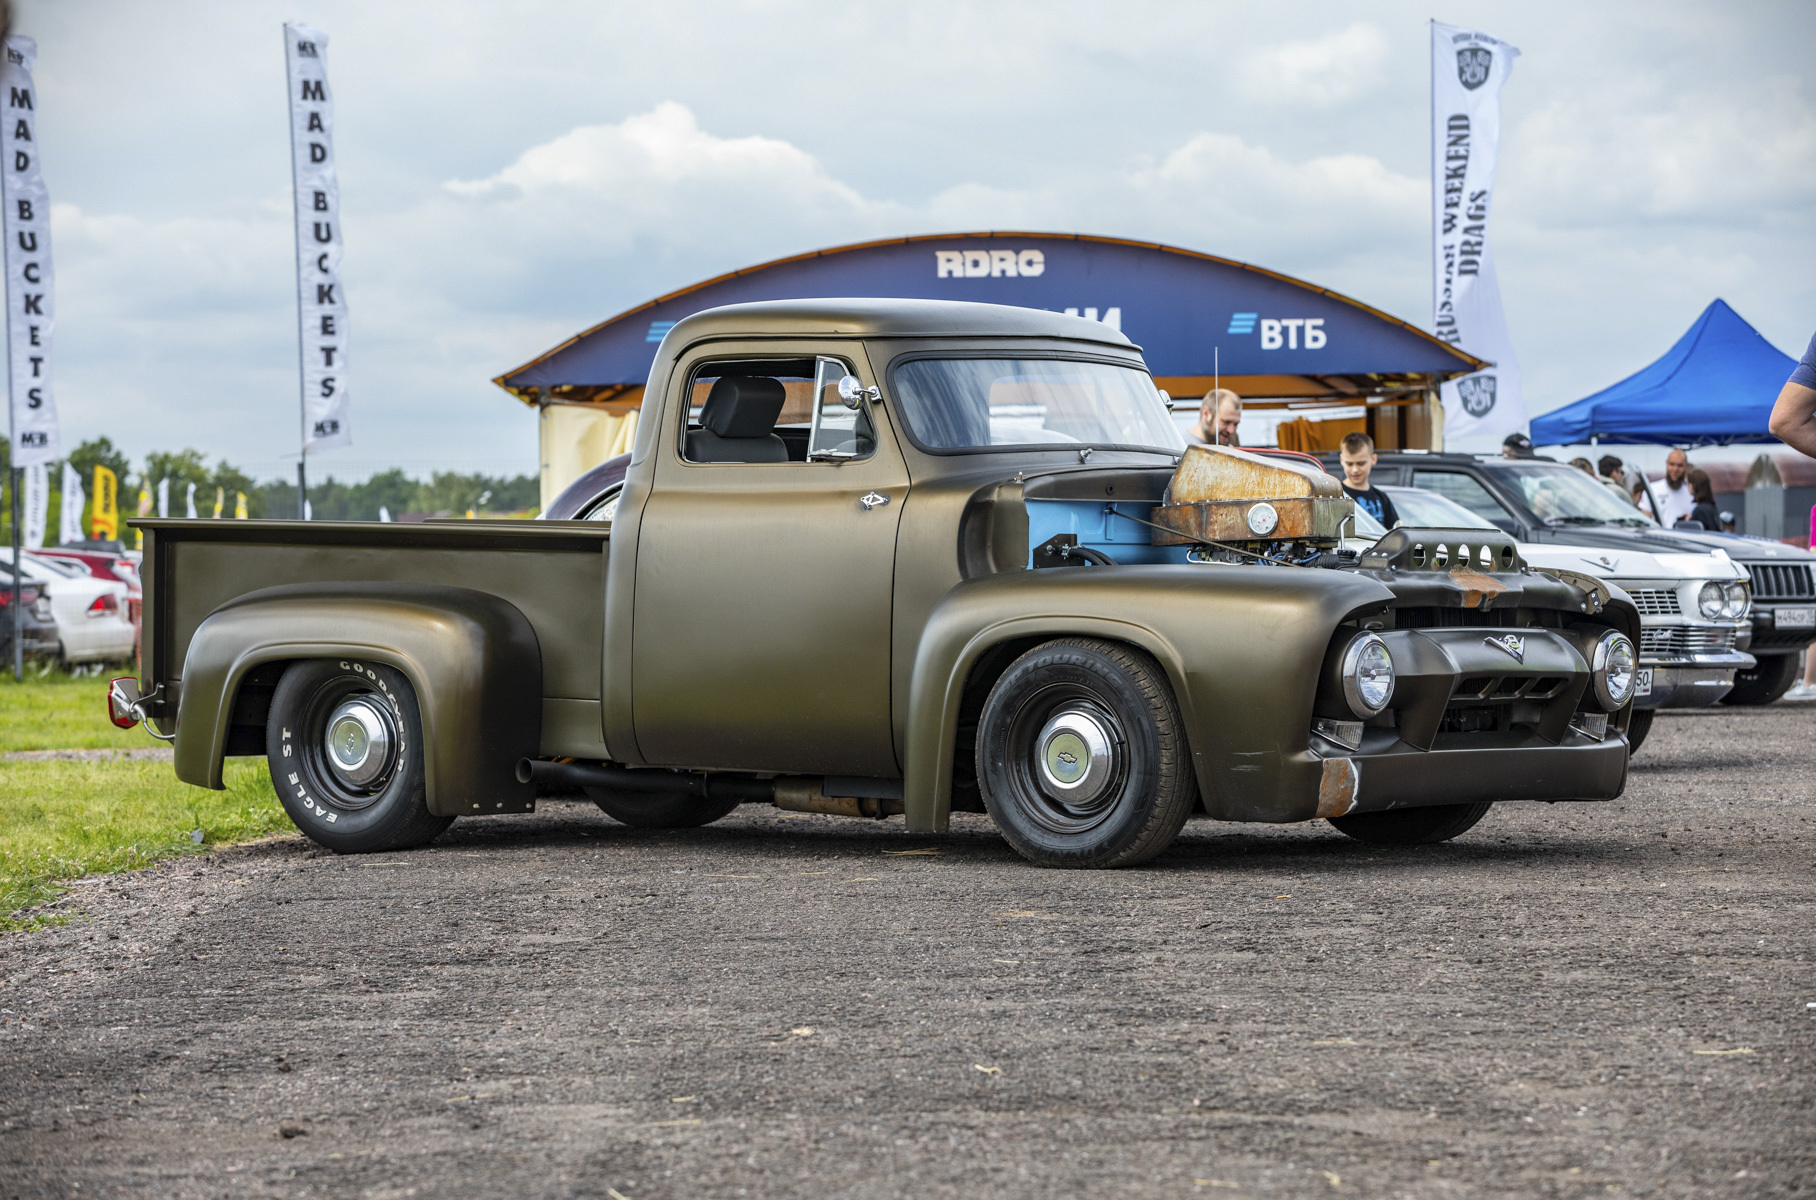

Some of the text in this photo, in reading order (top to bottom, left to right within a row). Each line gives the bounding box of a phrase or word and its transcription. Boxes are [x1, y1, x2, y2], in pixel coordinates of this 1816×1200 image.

[10, 86, 34, 173] MAD
[1442, 113, 1470, 235] WEEKEND
[301, 80, 337, 399] MAD BUCKETS
[935, 249, 1045, 278] RDRC
[1458, 190, 1488, 277] DRAGS
[18, 200, 44, 410] BUCKETS
[1260, 318, 1327, 350] ВТБ
[339, 660, 406, 773] GOODYEAR
[1025, 653, 1123, 689] TOURING
[282, 727, 338, 824] EAGLE ST
